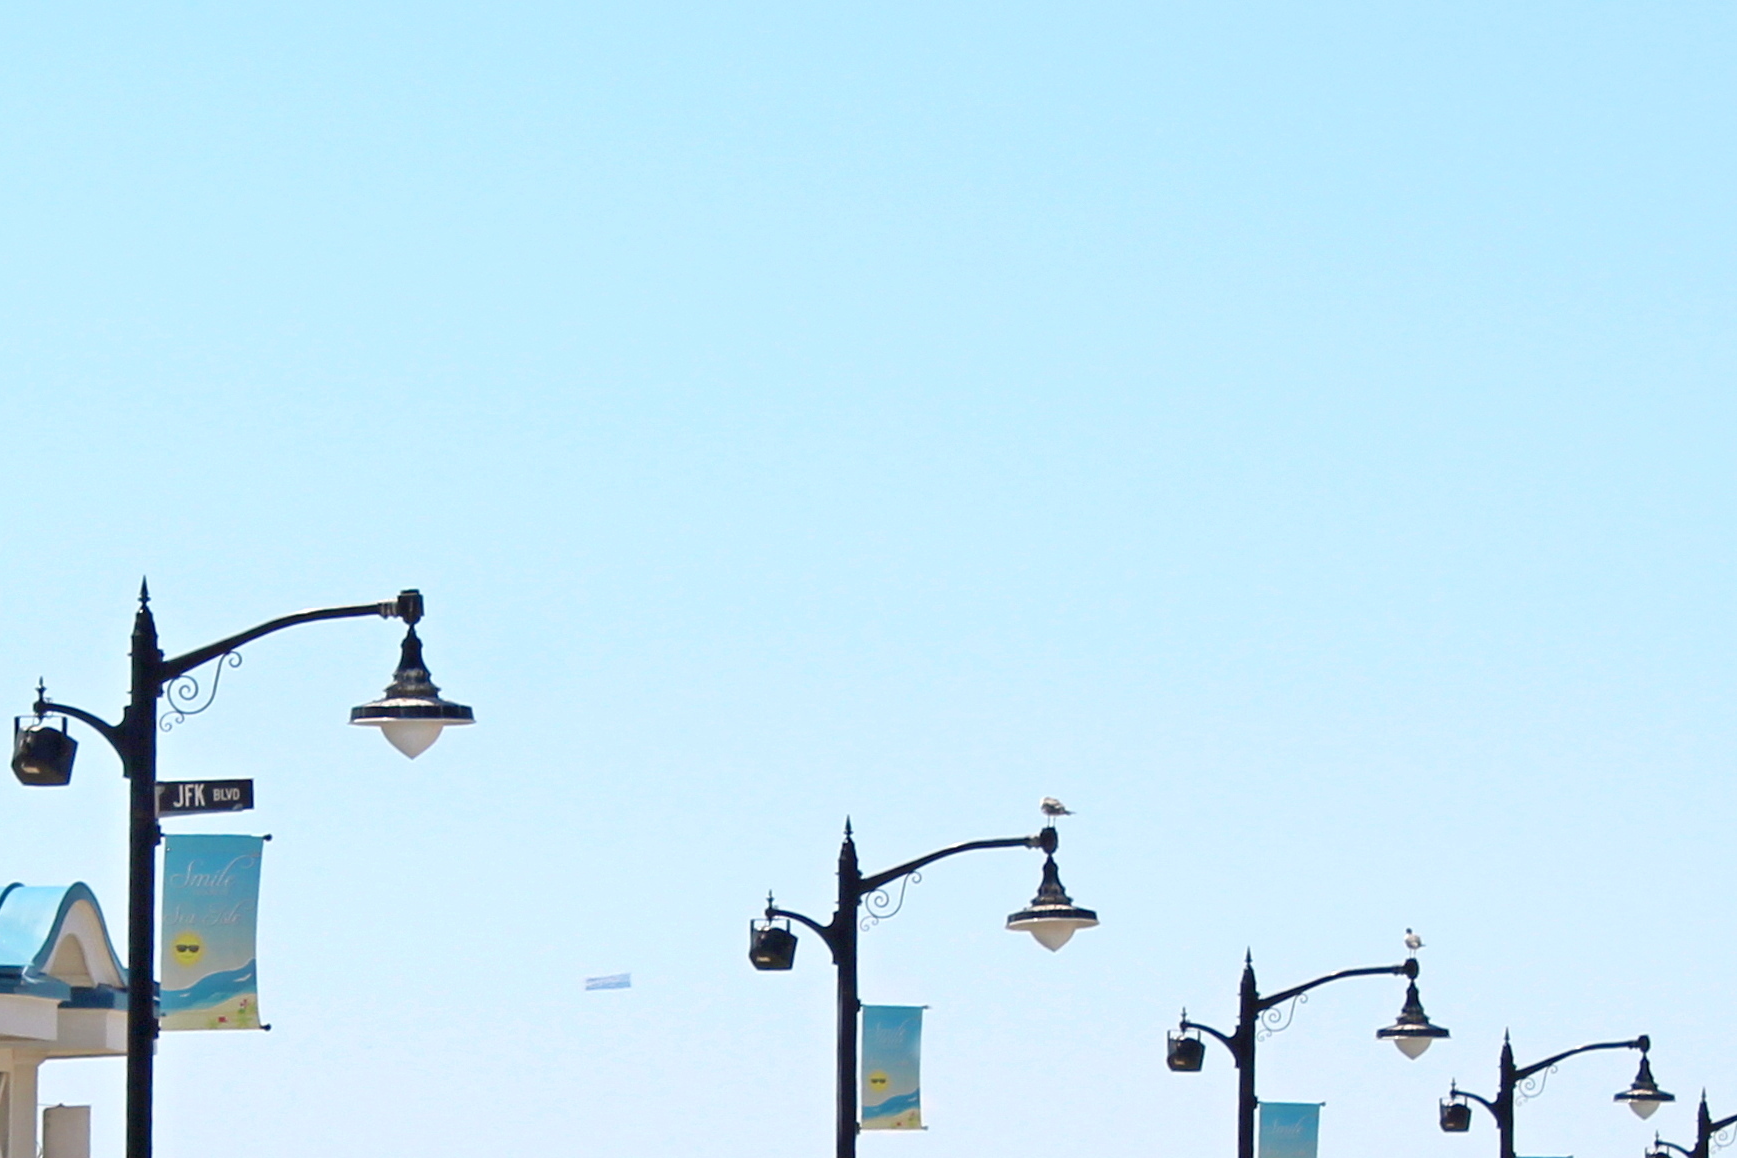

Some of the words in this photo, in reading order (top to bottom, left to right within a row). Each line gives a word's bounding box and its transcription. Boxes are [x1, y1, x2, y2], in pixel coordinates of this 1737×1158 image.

[172, 783, 206, 808] JFK
[212, 788, 241, 802] BLVD
[169, 854, 255, 889] Smile
